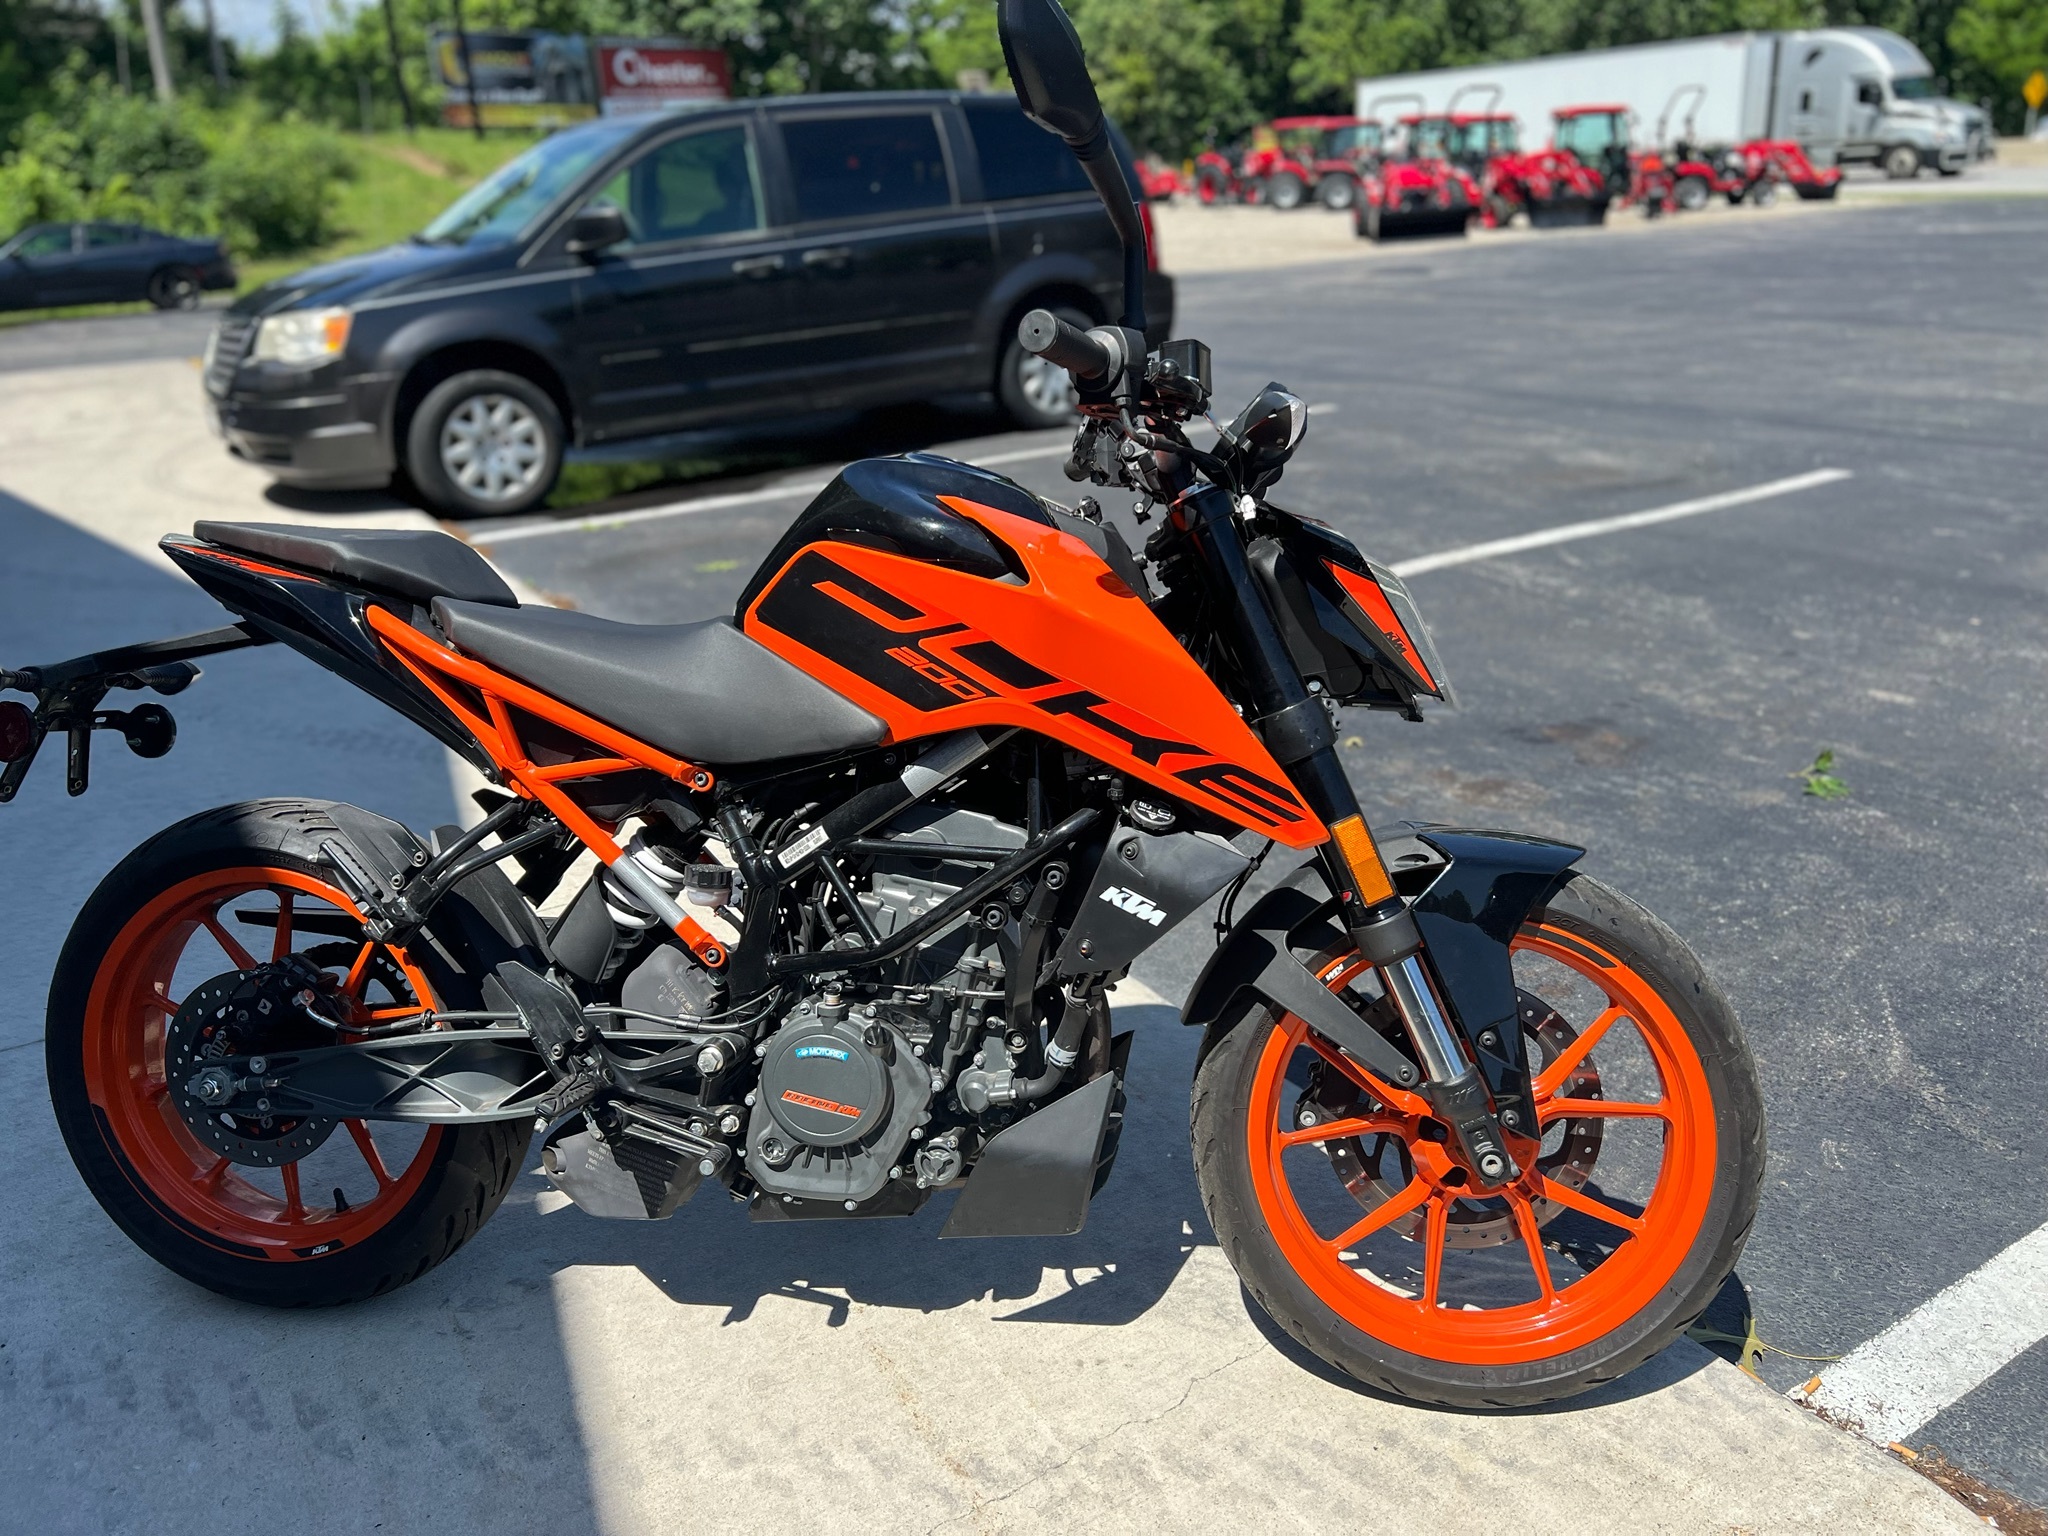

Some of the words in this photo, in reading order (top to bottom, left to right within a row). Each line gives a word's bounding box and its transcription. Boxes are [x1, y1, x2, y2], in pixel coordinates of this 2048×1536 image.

[1384, 630, 1408, 655] KTM
[884, 646, 987, 700] 200
[811, 562, 1308, 828] DUKE
[1099, 885, 1168, 927] KTM
[1324, 963, 1345, 982] KTM
[809, 1047, 845, 1060] MOTOREX
[311, 1244, 329, 1256] KTM
[1506, 1336, 1614, 1382] MICHELIN
